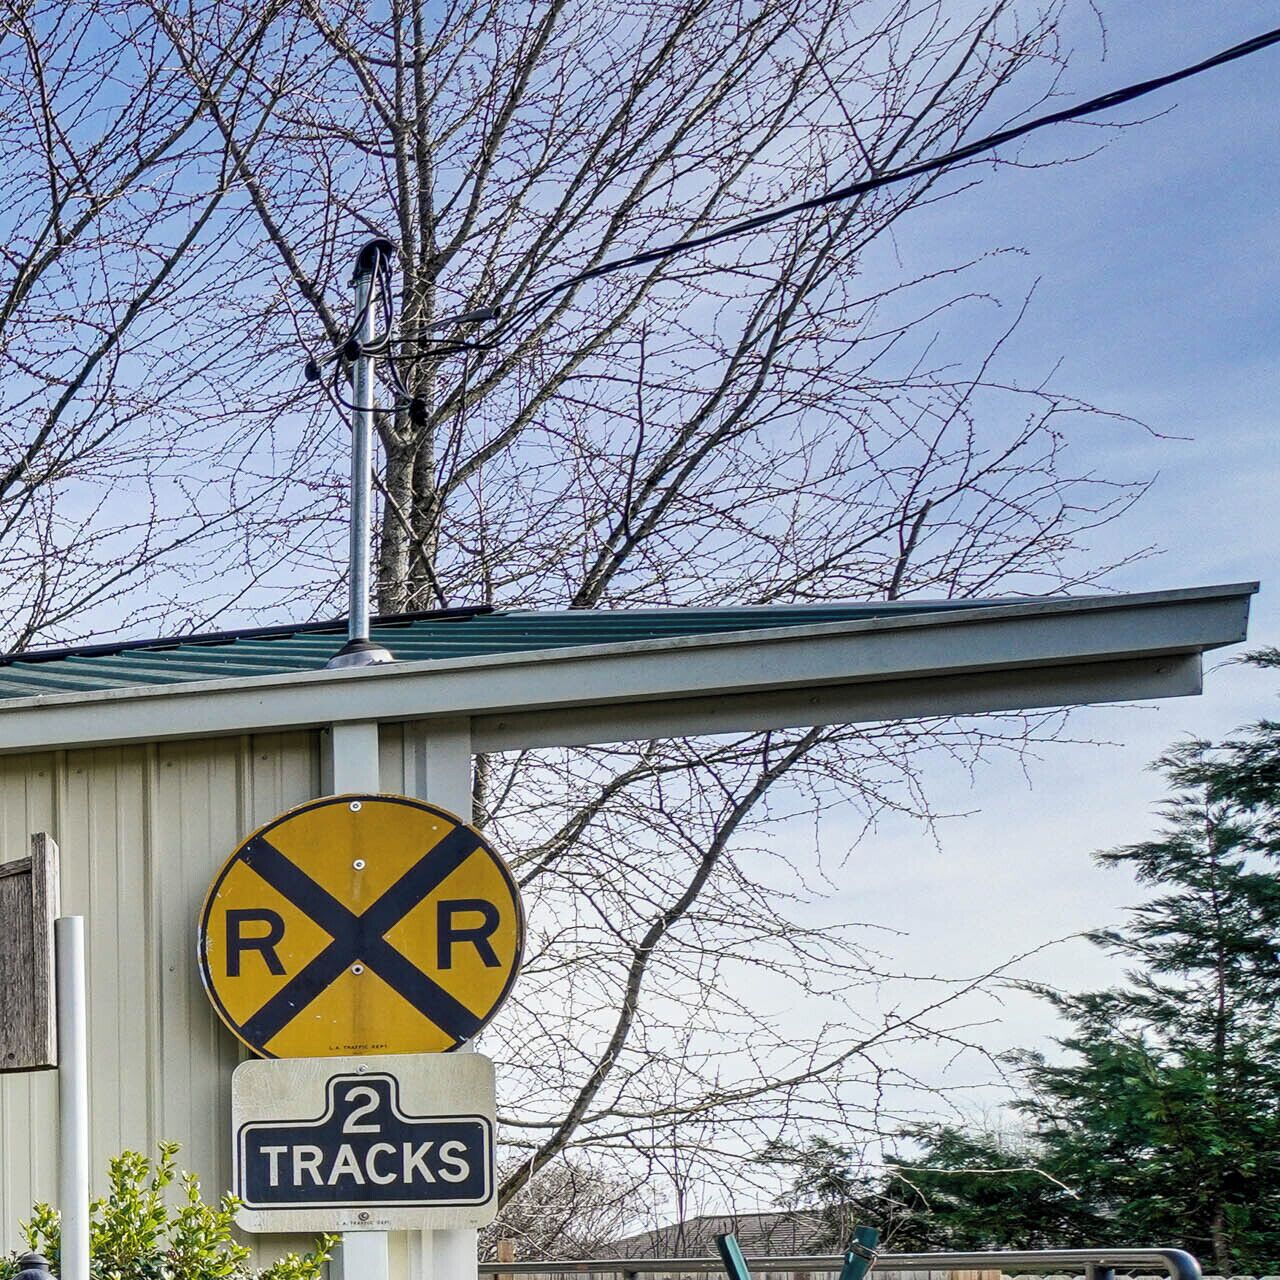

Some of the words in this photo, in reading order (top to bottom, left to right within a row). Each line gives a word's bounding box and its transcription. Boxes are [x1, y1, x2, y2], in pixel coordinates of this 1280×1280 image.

[226, 908, 287, 977] R
[437, 899, 502, 970] R
[342, 1086, 381, 1134] 2
[260, 1140, 470, 1187] TRACKS
